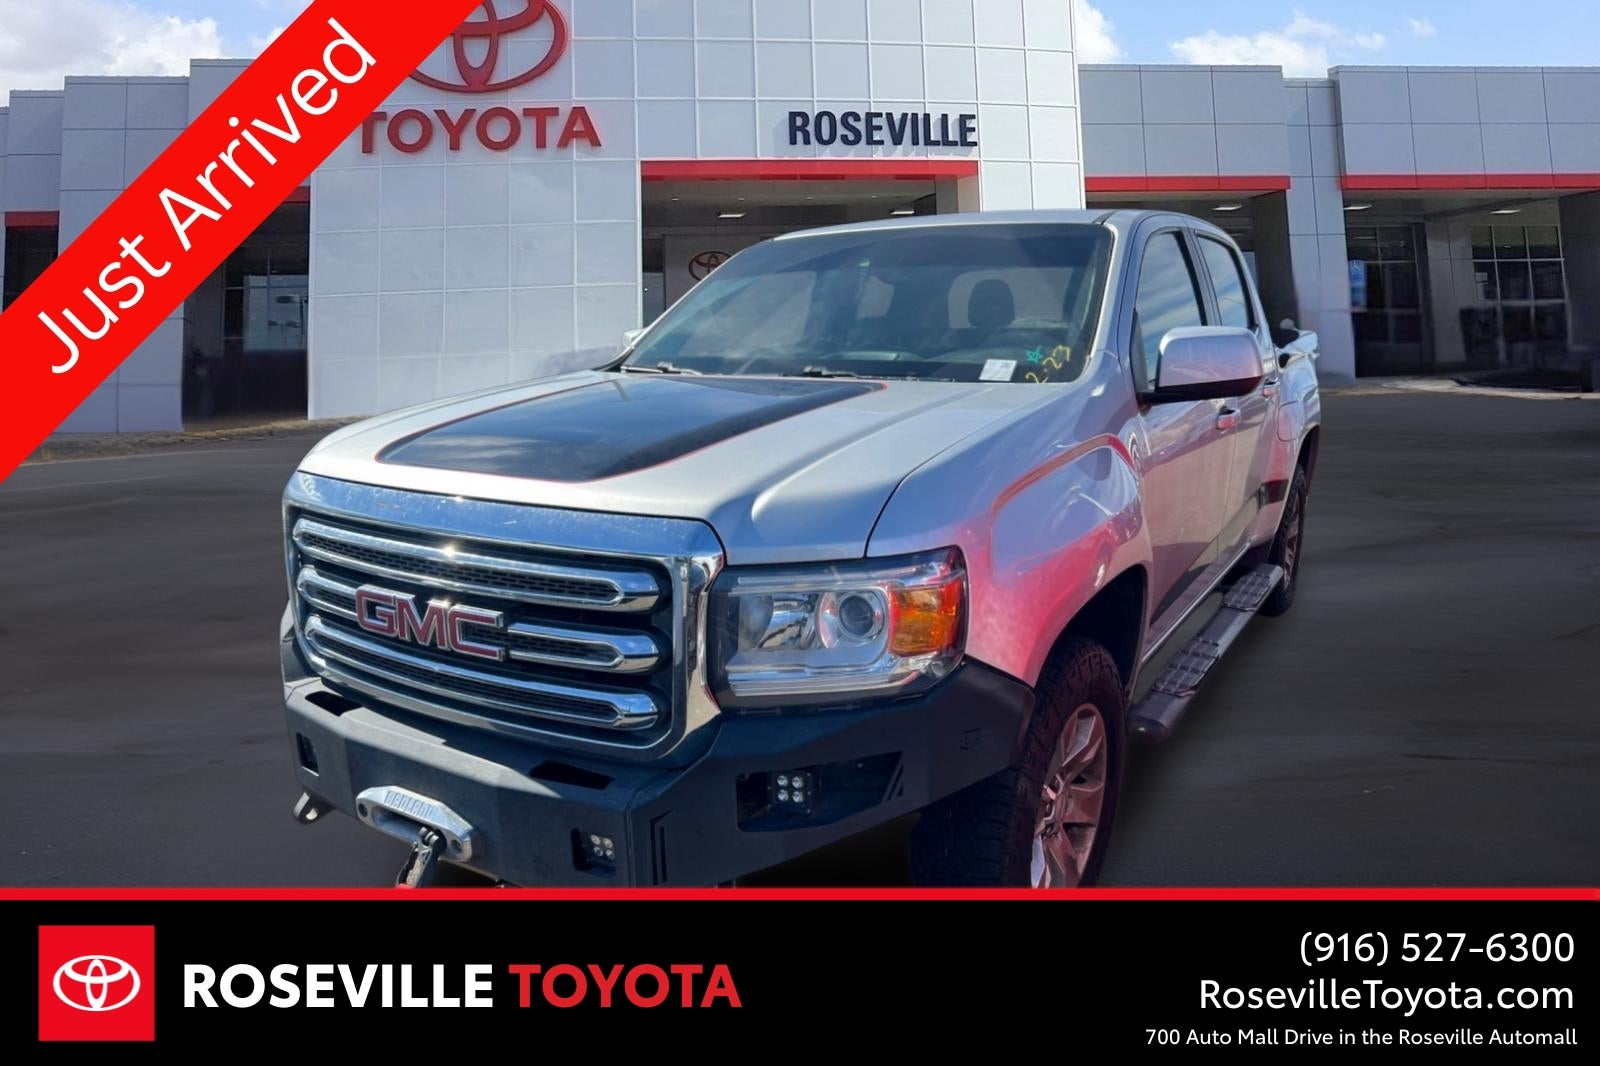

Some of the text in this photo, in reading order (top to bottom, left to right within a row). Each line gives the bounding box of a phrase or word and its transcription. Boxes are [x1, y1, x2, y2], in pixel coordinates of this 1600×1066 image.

[361, 107, 602, 154] TOYOTA
[788, 111, 977, 147] ROSEVILLE
[356, 584, 503, 661] GMC
